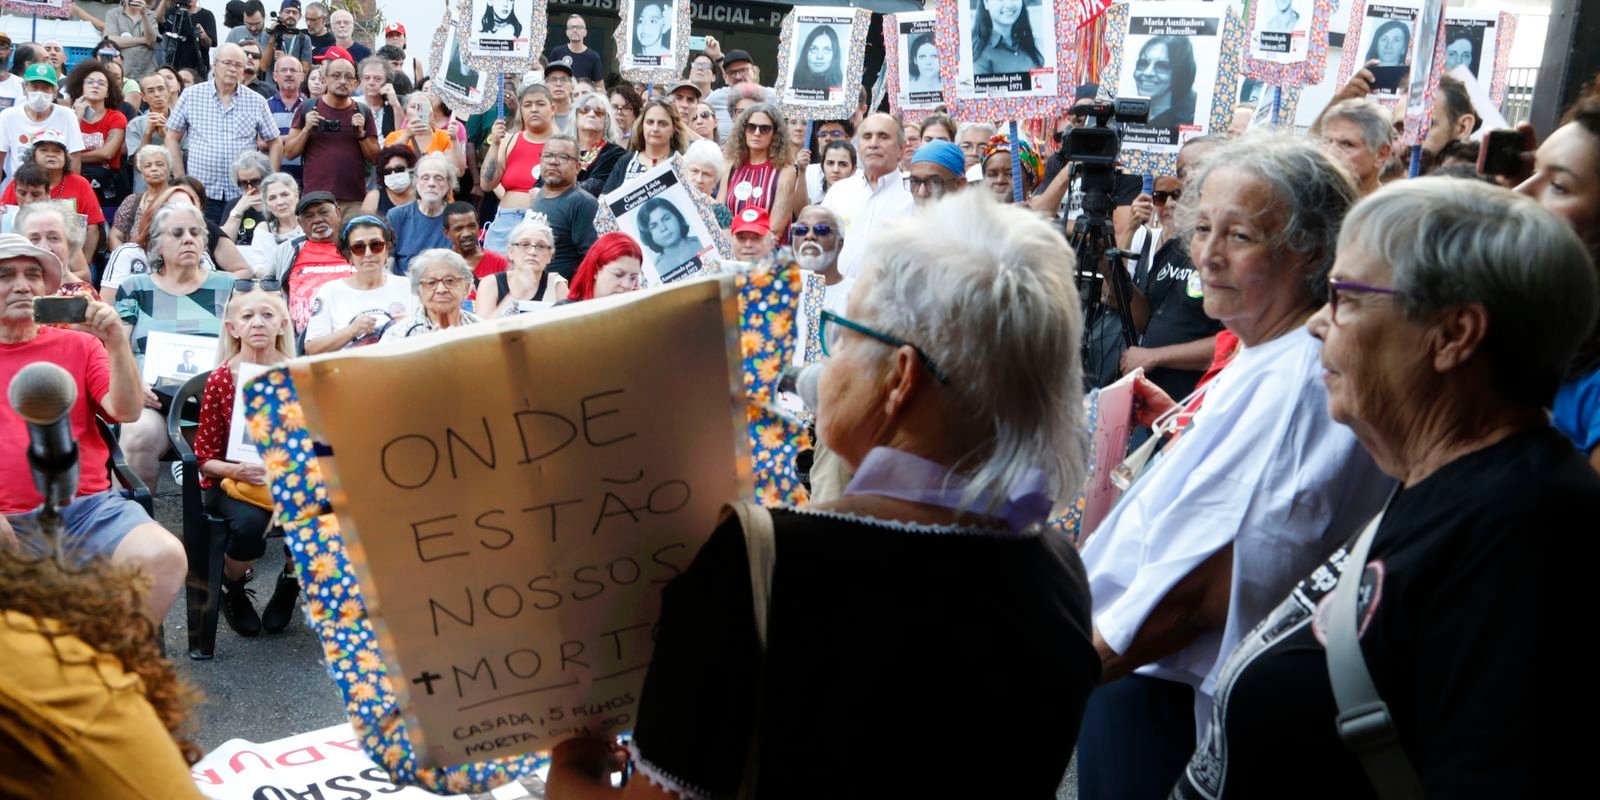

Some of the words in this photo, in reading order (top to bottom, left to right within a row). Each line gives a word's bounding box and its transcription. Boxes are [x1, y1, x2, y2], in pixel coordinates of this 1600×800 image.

[689, 2, 754, 24] OLICIAL
[1143, 17, 1164, 26] Maria
[1164, 18, 1205, 27] Auxiliadora
[1148, 26, 1164, 35] Lara
[1165, 26, 1197, 35] Barcellos
[1009, 74, 1022, 83] pela
[1158, 128, 1170, 136] pela
[381, 389, 637, 490] ONDE
[410, 468, 690, 563] ESTÃO
[429, 543, 687, 637] NOSSOS
[452, 622, 650, 698] MORT
[549, 706, 564, 721] 5
[464, 731, 537, 756] MORTA
